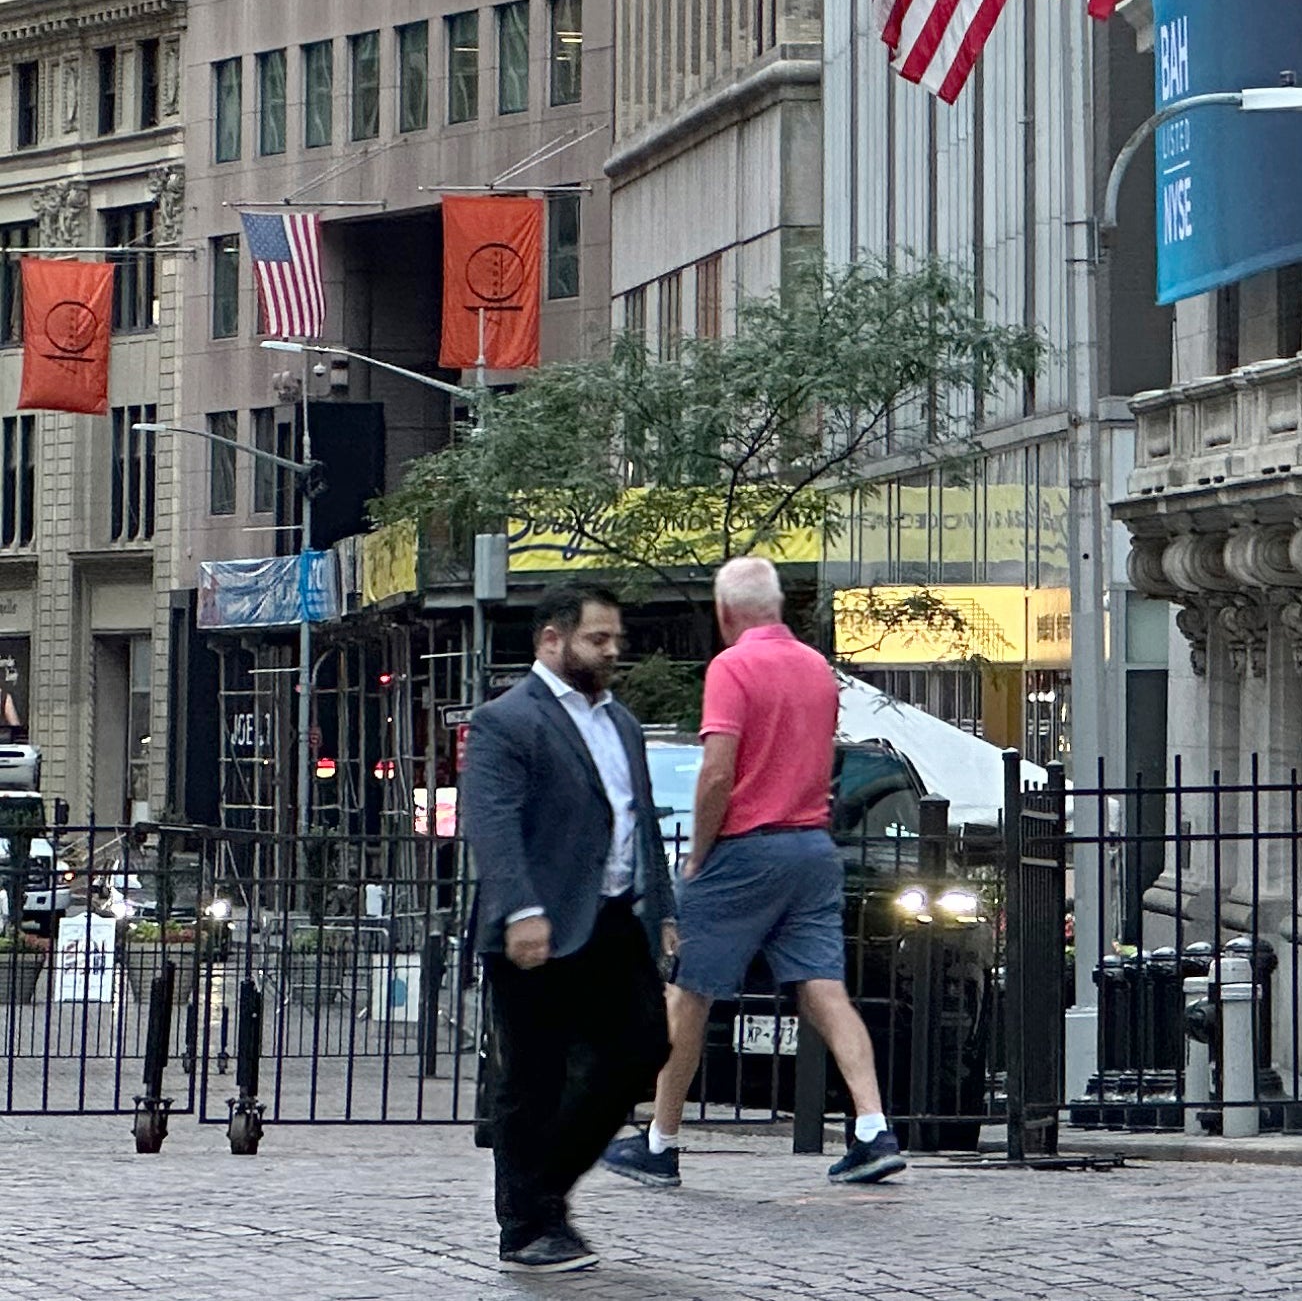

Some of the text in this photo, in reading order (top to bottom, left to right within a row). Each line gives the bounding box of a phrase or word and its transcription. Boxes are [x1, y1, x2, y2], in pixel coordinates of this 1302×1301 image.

[1160, 15, 1190, 101] BAH
[1162, 117, 1191, 159] LISTED
[1163, 176, 1193, 245] NYSE
